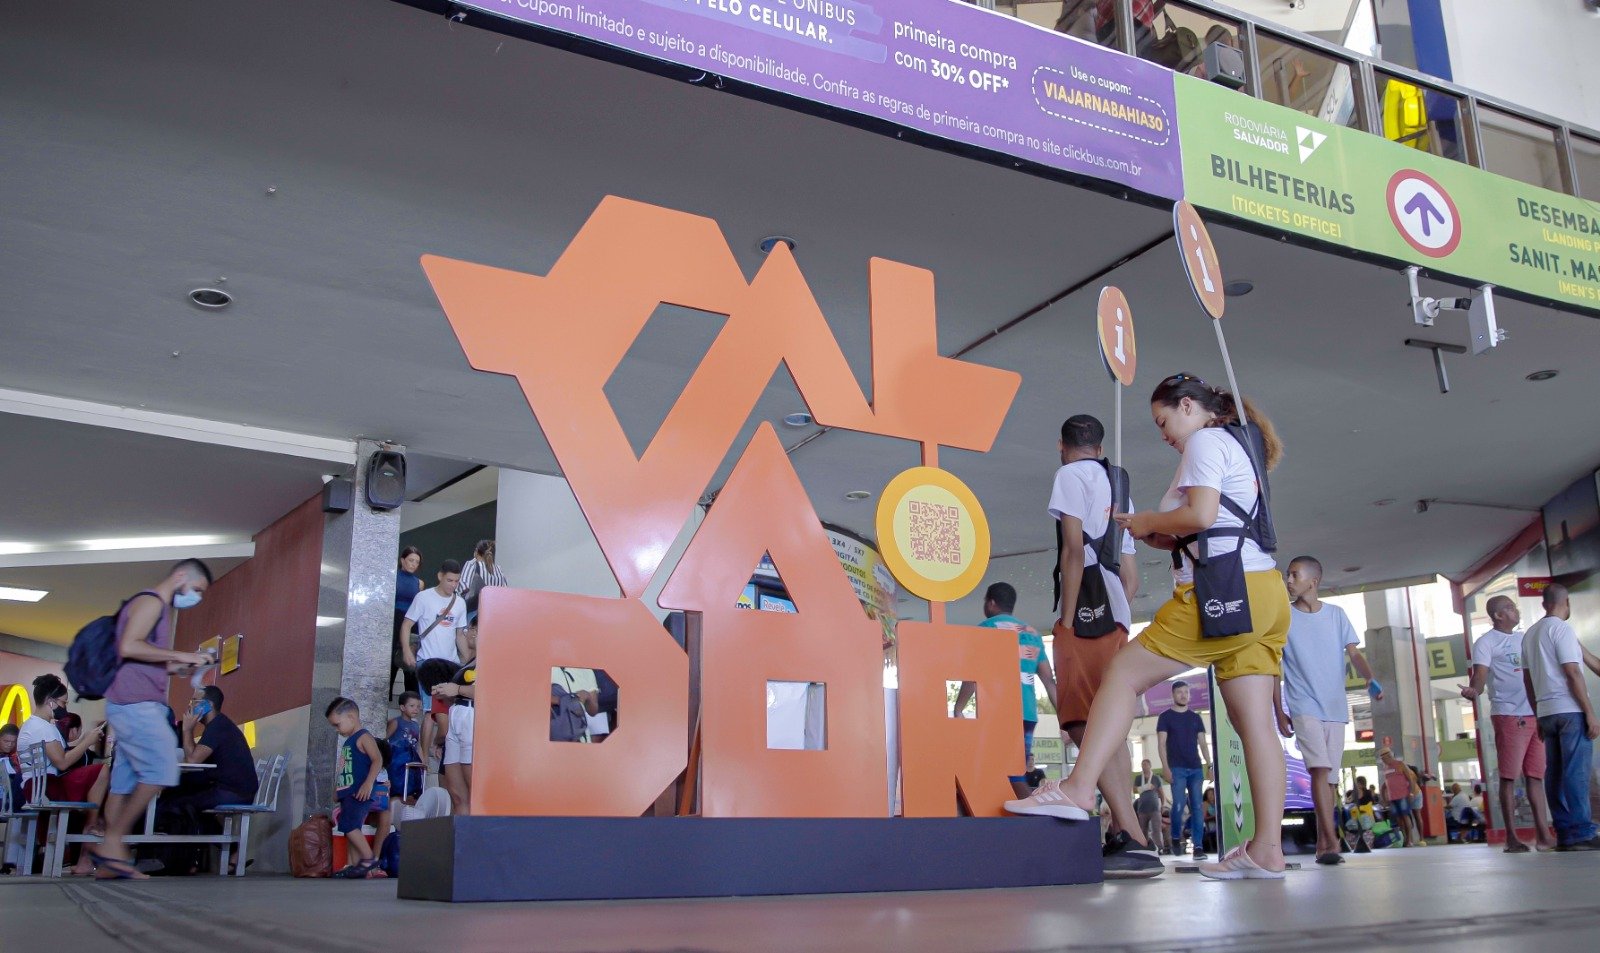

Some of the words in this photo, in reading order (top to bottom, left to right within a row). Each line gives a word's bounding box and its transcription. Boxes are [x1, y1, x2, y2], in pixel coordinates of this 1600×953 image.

[702, 0, 743, 16] ELO
[749, 4, 833, 44] CELULAR.
[894, 20, 956, 54] primeira
[959, 43, 1017, 70] compra
[894, 51, 927, 74] com
[930, 58, 965, 85] 30%
[1070, 65, 1088, 82] Use
[1090, 75, 1096, 84] o
[1098, 75, 1132, 96] cupom:
[577, 5, 633, 37] limitado
[637, 28, 645, 41] e
[650, 31, 694, 53] sujeito
[698, 44, 706, 57] a
[709, 44, 810, 87] disponibilidade.
[813, 73, 859, 99] Confira
[862, 90, 876, 104] as
[878, 93, 914, 116] regras
[916, 104, 931, 120] de
[933, 110, 980, 134] primeira
[982, 124, 1025, 145] compra
[1027, 136, 1040, 150] no
[1042, 138, 1061, 155] site
[1063, 143, 1142, 177] clickbus.com.br
[1043, 80, 1164, 132] VIAJARNABAHIA30
[1233, 128, 1290, 155] SALVADOR
[1211, 153, 1356, 215] BILHETERIAS
[1232, 194, 1290, 224] (TICKETS
[1294, 213, 1342, 238] OFFICE)
[1542, 227, 1592, 251] (LANDING
[1509, 242, 1567, 276] SANIT.
[1570, 259, 1600, 283] MA
[1558, 280, 1596, 300] (MEN'S
[841, 562, 867, 579] ODUTOS
[848, 575, 866, 588] ENTO
